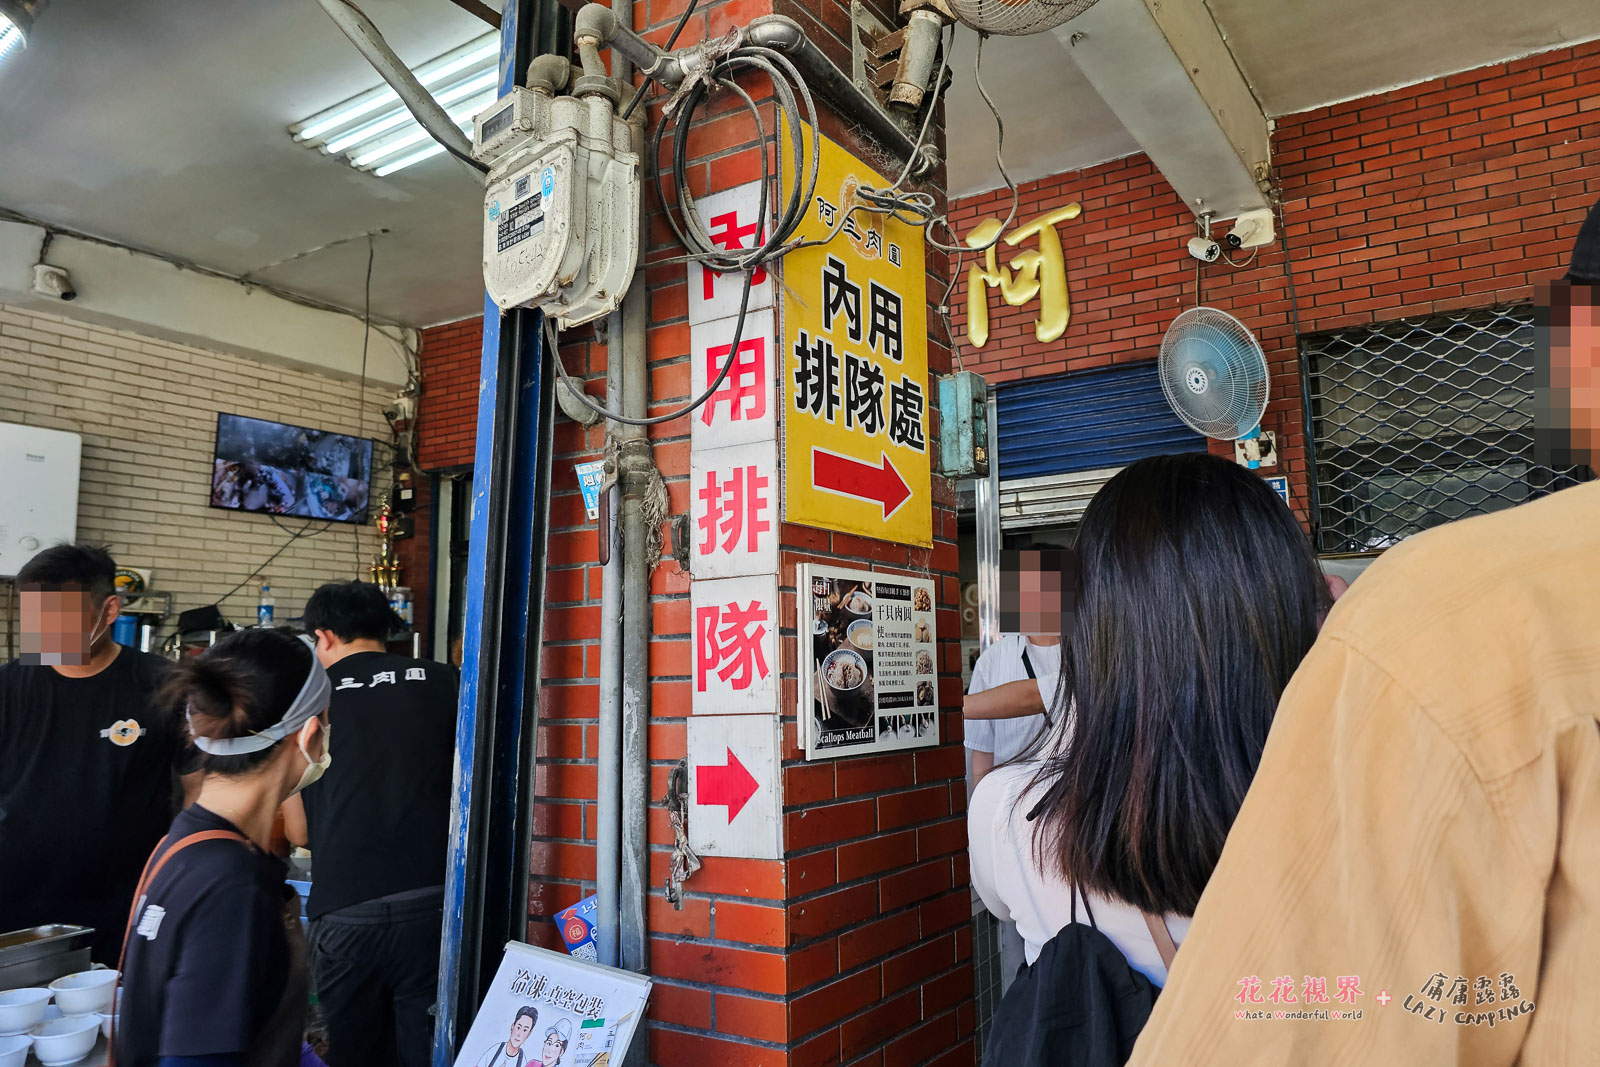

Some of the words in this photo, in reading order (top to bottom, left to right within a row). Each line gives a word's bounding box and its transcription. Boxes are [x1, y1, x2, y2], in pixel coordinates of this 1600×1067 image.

[965, 202, 1082, 348] 阿
[795, 332, 925, 451] 排隊處
[845, 727, 874, 741] Meatball
